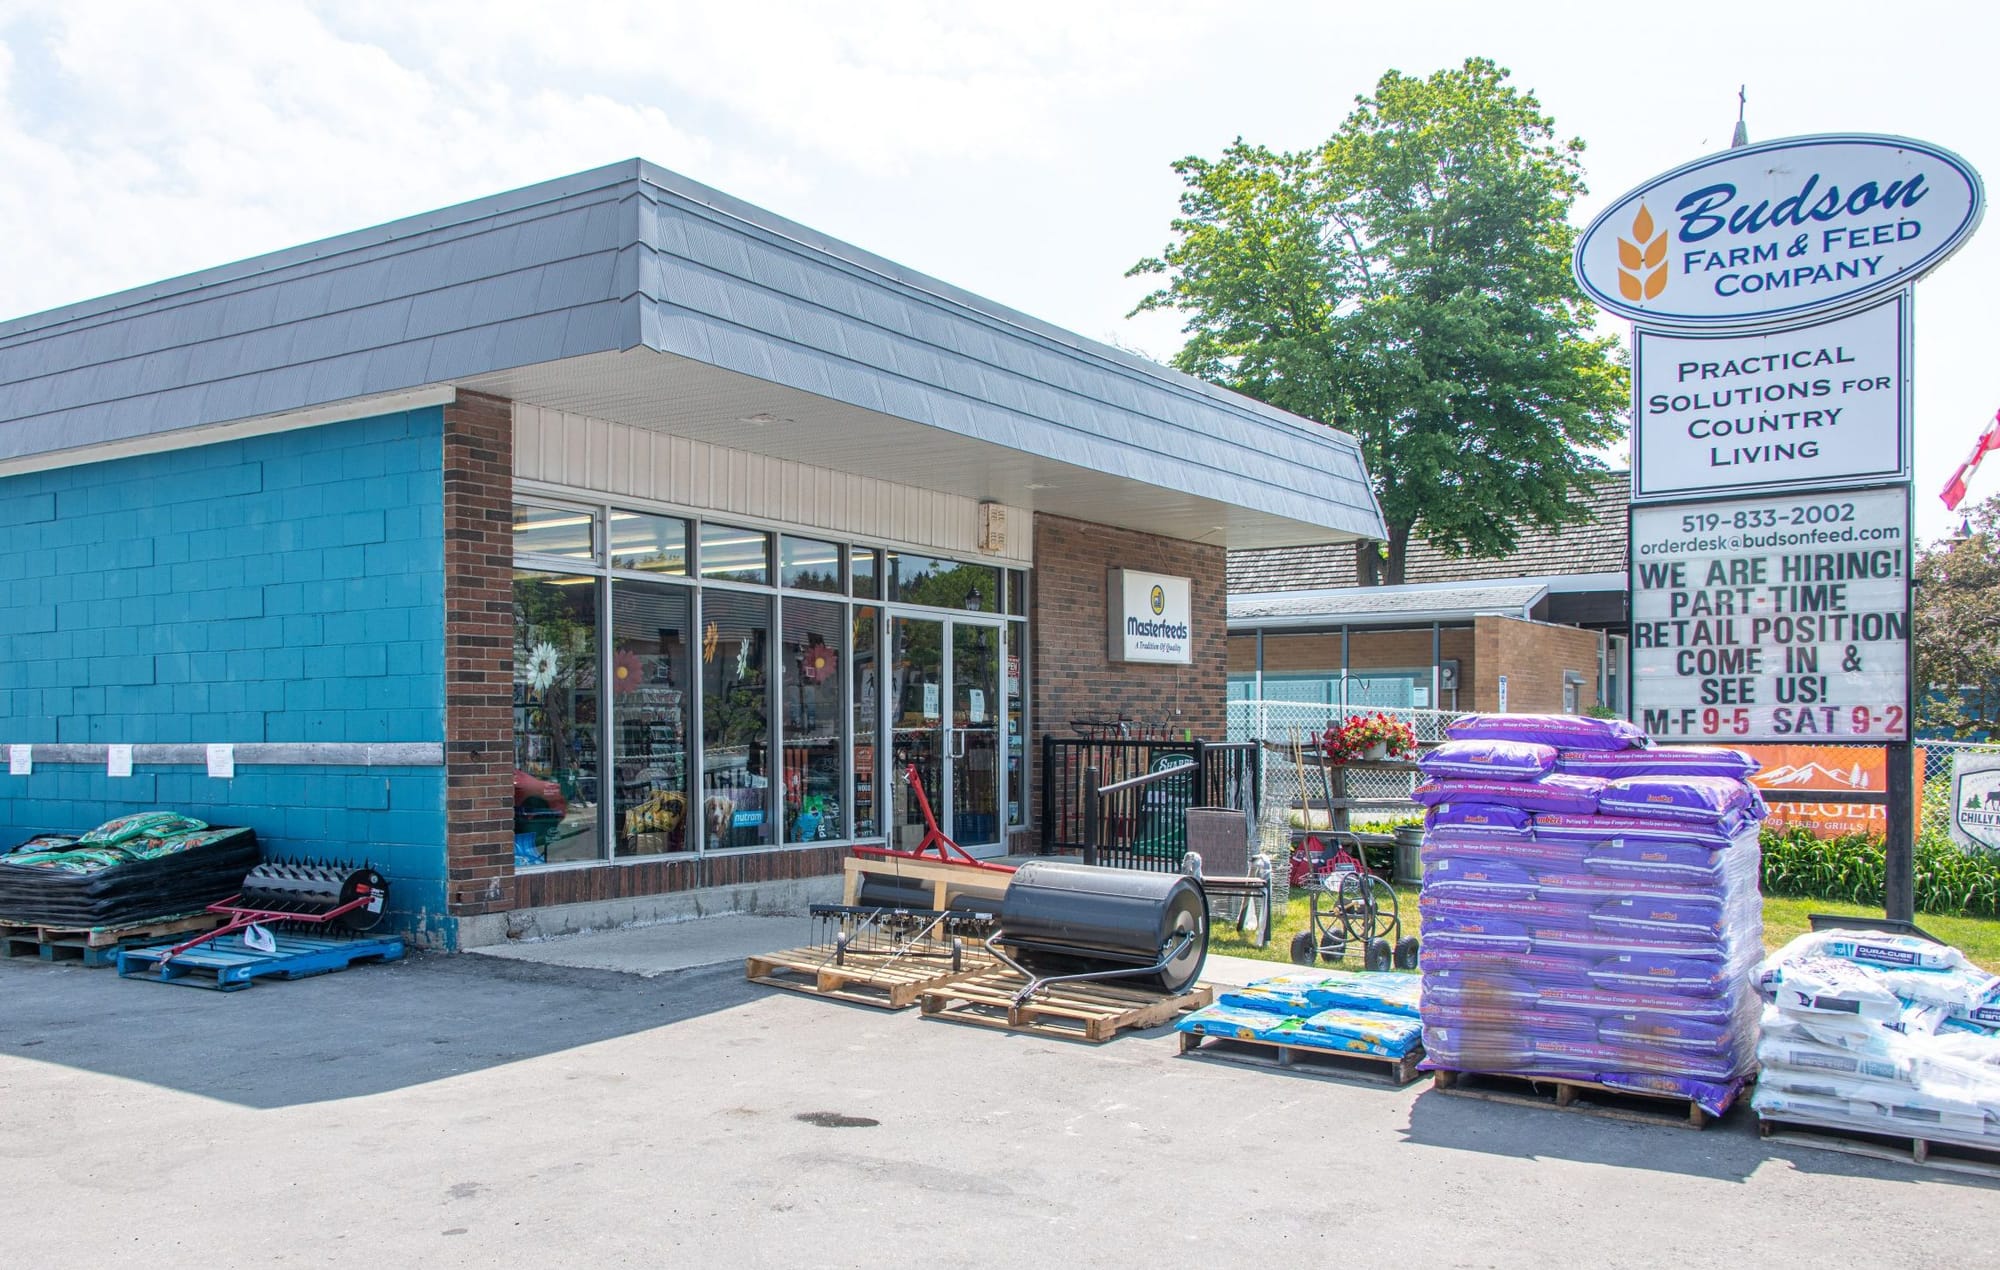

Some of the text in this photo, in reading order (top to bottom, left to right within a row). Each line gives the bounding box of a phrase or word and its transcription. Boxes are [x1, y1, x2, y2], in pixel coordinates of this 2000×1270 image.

[1674, 172, 1929, 243] Budson
[1683, 219, 1921, 274] FARM & FEED
[1714, 255, 1884, 297] COMPANY
[1677, 346, 1855, 382] PRACTICAL
[1649, 376, 1891, 414] SOLUTIONS FOR
[1688, 407, 1843, 439] COUNTRY
[1710, 441, 1819, 467] LIVING
[1682, 503, 1855, 533] 519-833-2002
[1641, 526, 1900, 555] orderdesk@budsonfeed.com
[1639, 549, 1901, 590] WE ARE HIRING!
[1671, 584, 1846, 617] PART-TIME
[1127, 616, 1187, 639] Masterfeeds
[1635, 613, 1907, 648] RETAIL POSITION
[1677, 645, 1862, 676] COME IN &
[1701, 676, 1827, 704] SEE US!
[1644, 705, 1903, 735] M-F 9-5 SAT 9-2
[1825, 821, 1865, 831] GRILLS
[1960, 812, 1994, 825] CHILLY
